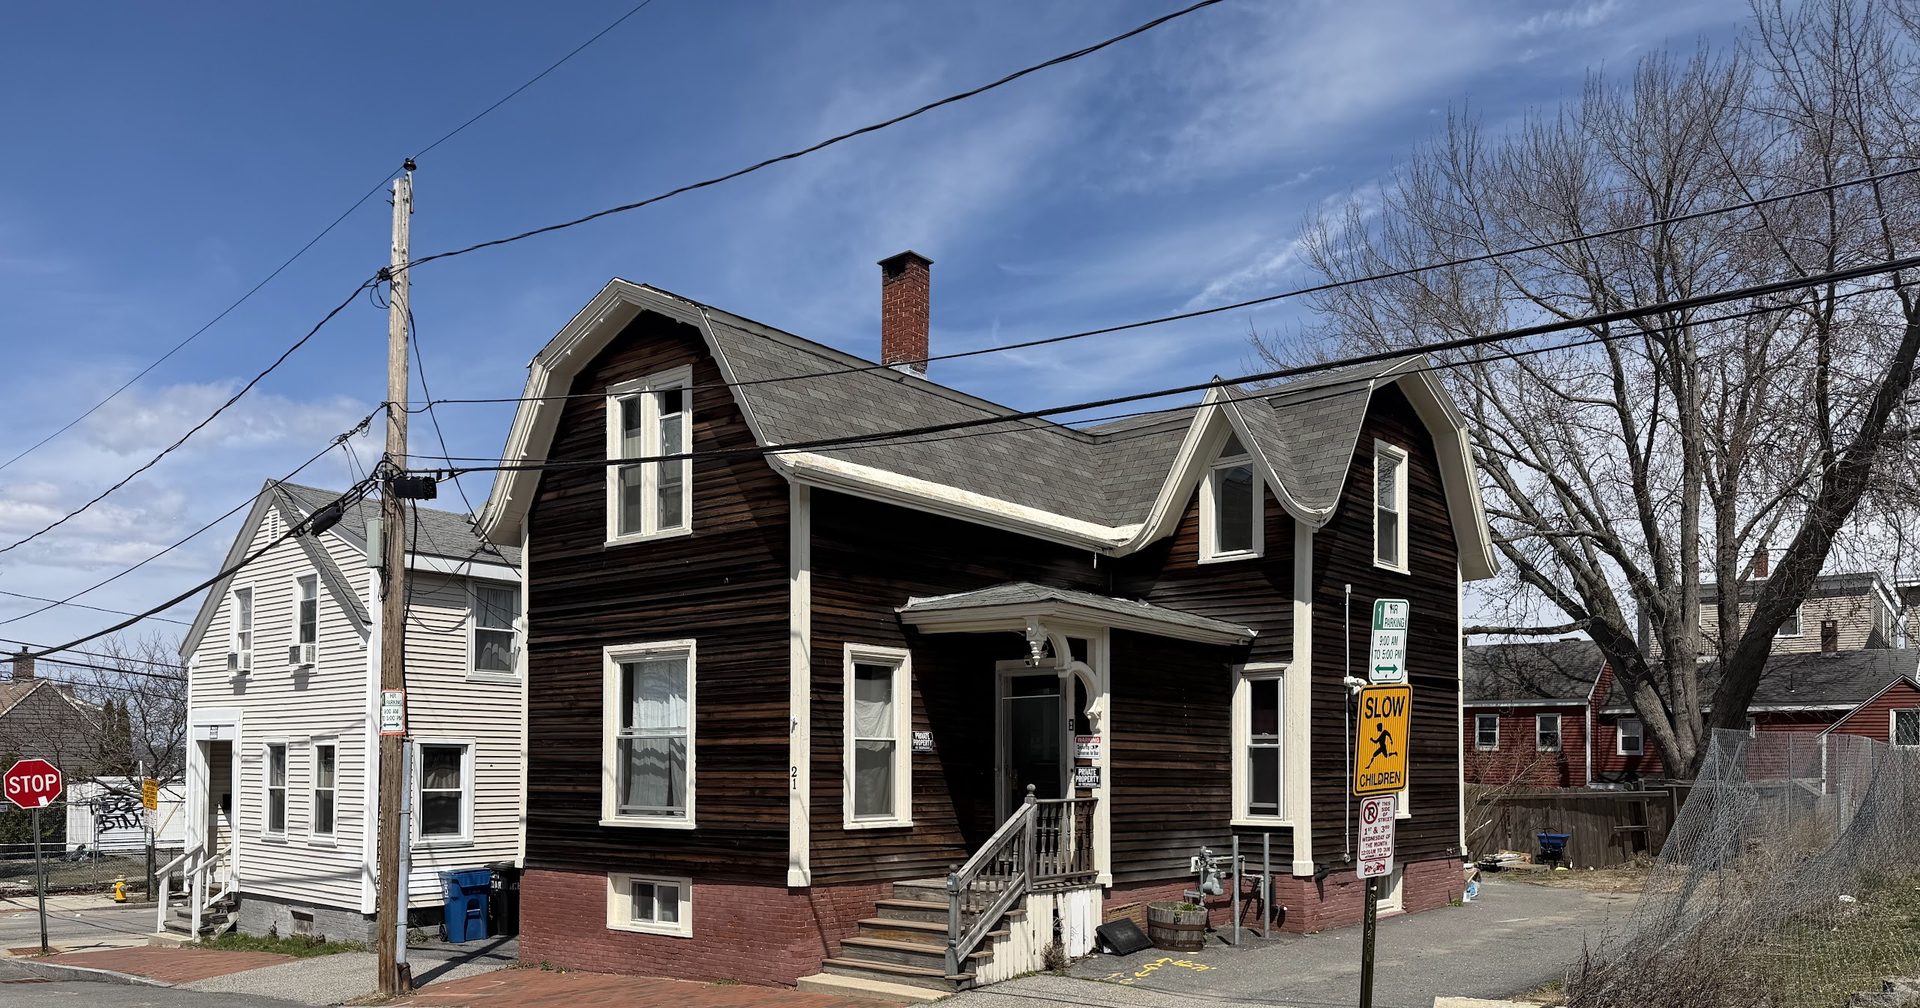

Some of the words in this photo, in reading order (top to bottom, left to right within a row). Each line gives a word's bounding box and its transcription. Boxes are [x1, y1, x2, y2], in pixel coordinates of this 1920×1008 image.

[1378, 604, 1382, 625] 1
[1384, 617, 1404, 628] PARKING
[1379, 635, 1390, 646] 9:00
[1391, 635, 1399, 646] AM
[1374, 649, 1380, 660] TO
[1381, 649, 1393, 660] 5:00
[1394, 649, 1402, 660] PM
[1365, 696, 1405, 719] SLOW
[1078, 768, 1097, 776] PRIVATE
[9, 774, 57, 794] STOP
[1075, 775, 1100, 783] PROPERTY
[1360, 771, 1401, 787] CHILDREN
